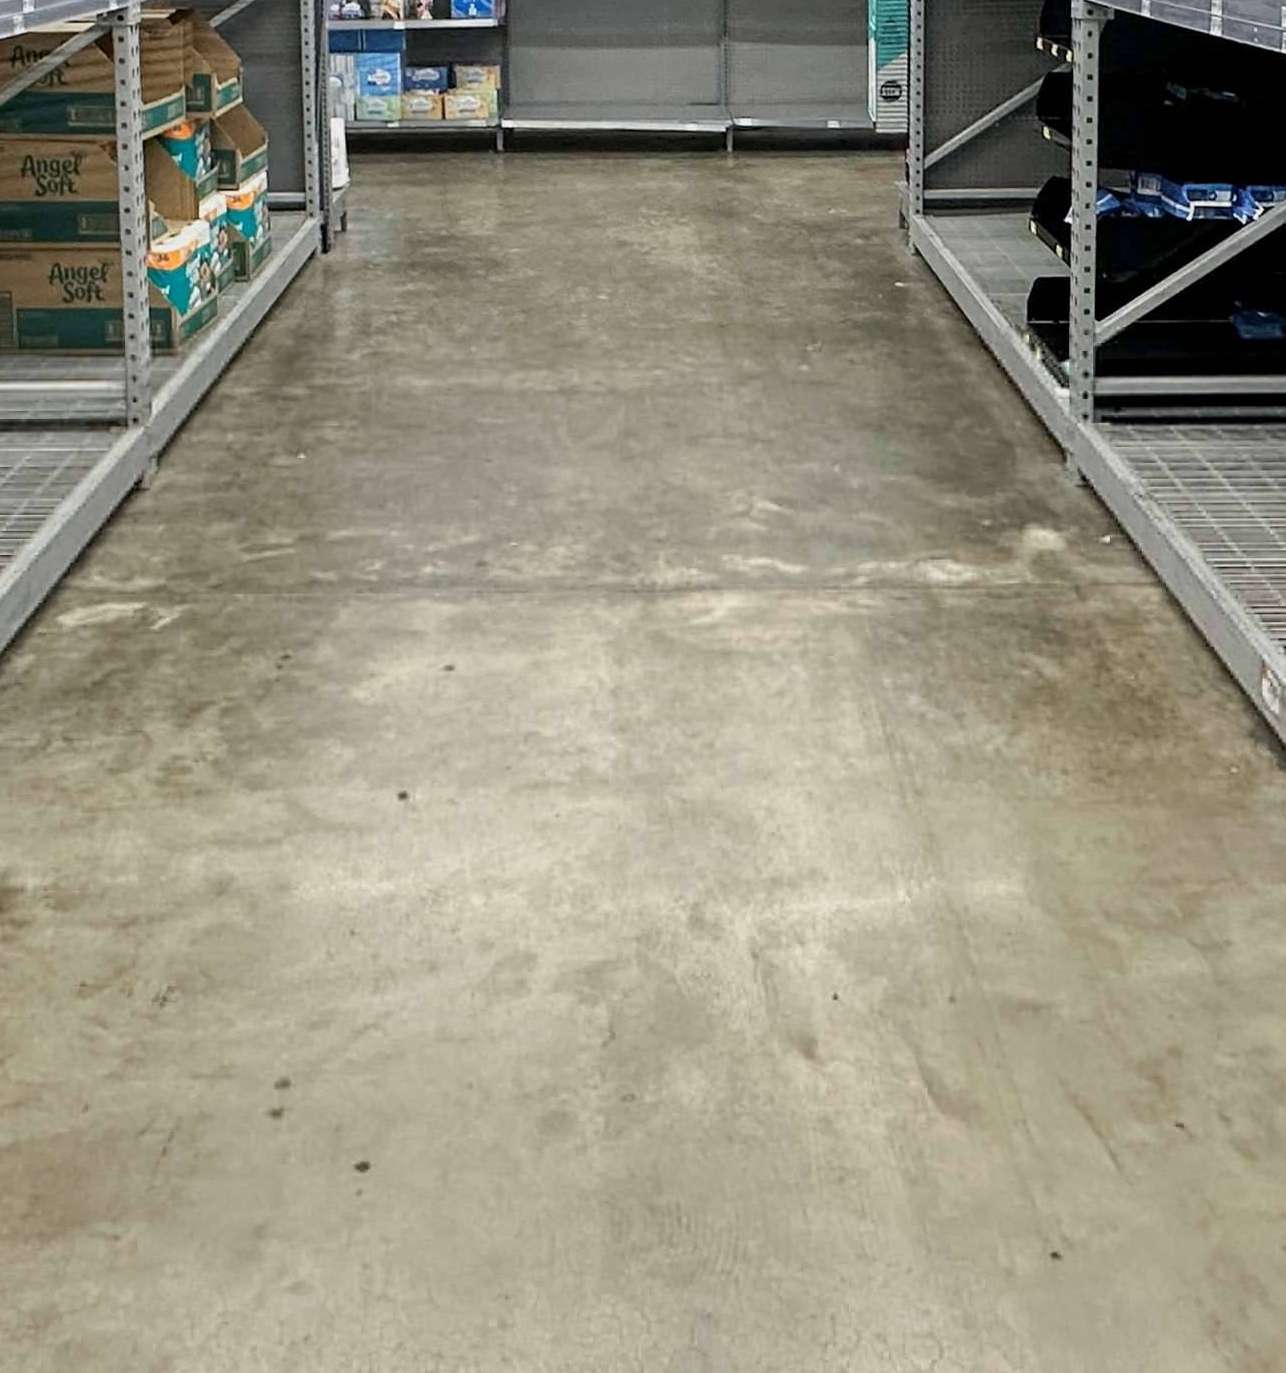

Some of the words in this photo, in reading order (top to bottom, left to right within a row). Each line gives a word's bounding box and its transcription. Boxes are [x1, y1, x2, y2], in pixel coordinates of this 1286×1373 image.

[20, 153, 82, 180] Angel
[34, 176, 77, 197] Soft
[49, 263, 110, 288] Angel
[62, 284, 105, 304] Soft
